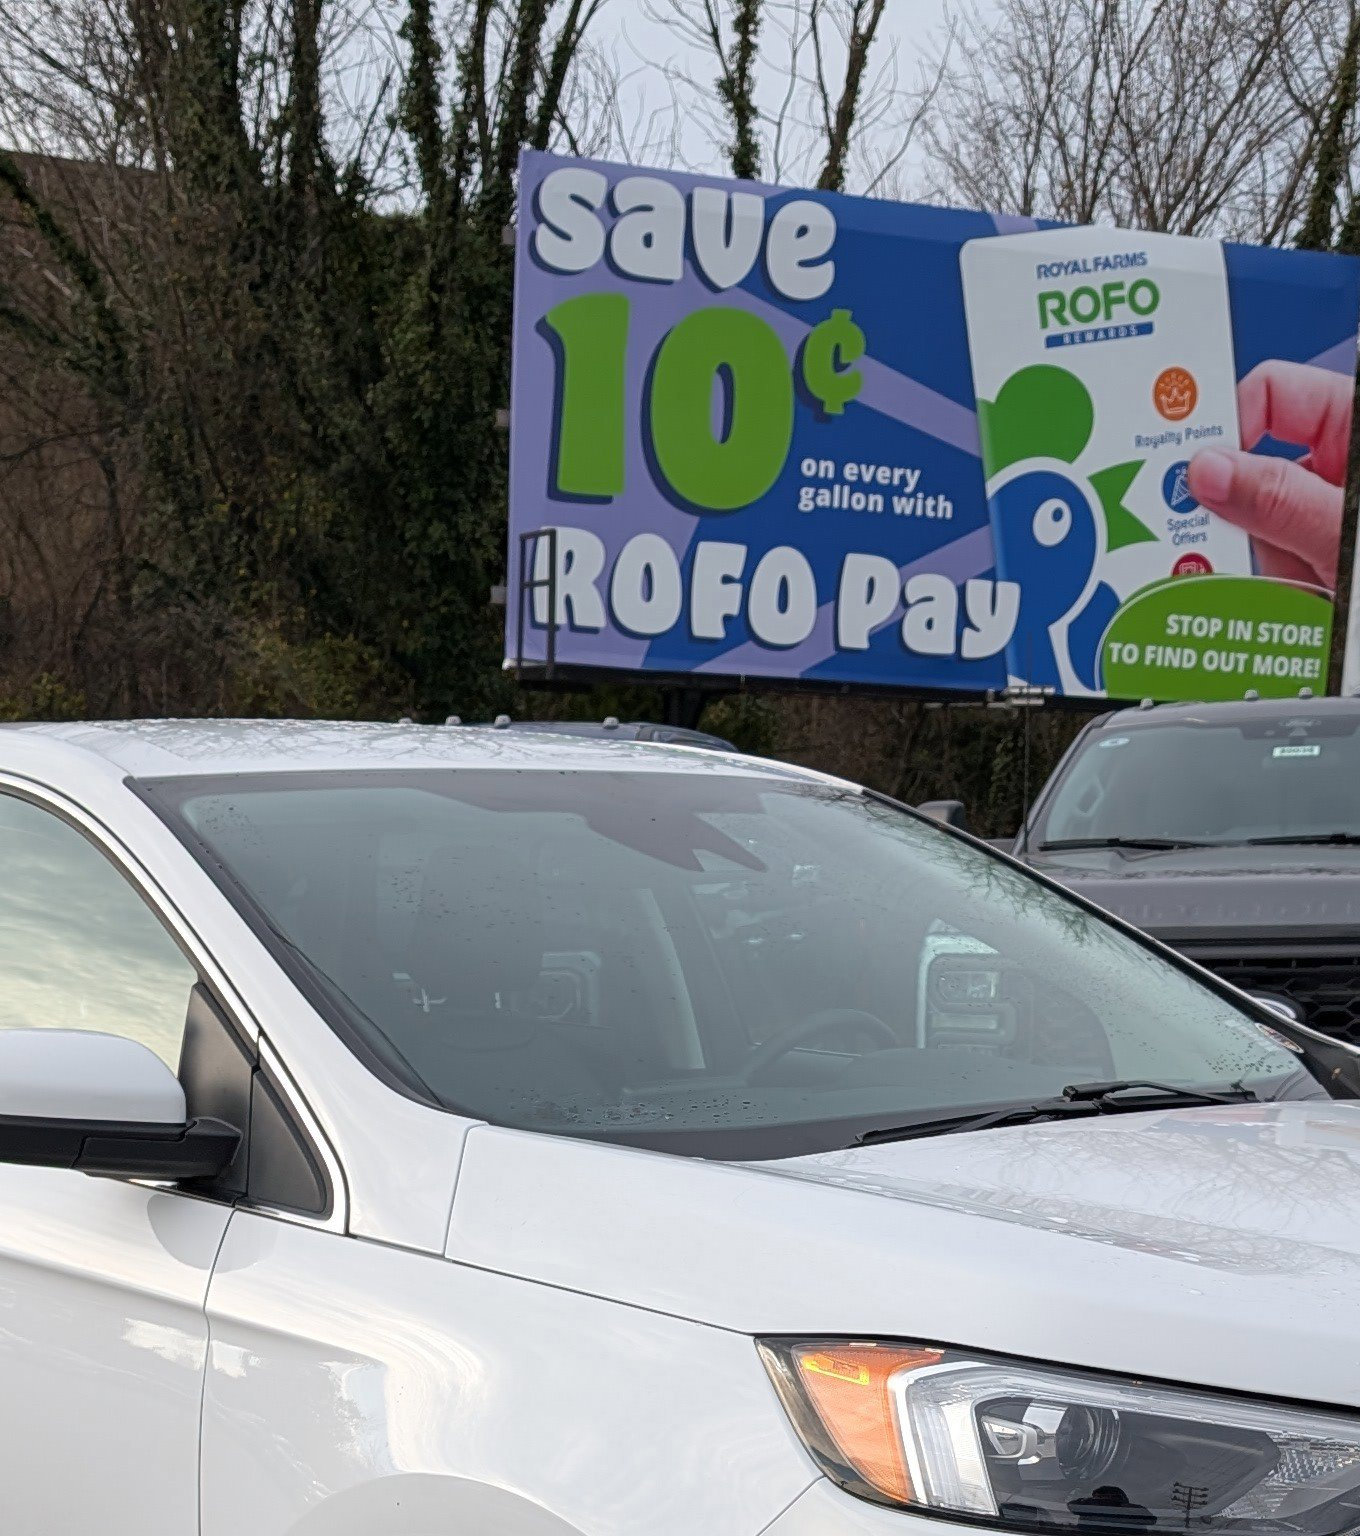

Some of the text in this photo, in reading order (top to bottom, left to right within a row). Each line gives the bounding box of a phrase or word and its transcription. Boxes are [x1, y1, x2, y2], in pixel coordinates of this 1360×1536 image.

[1036, 251, 1148, 280] ROYAL FARMS
[1038, 277, 1160, 330] ROFO
[1062, 323, 1139, 345] REWARDS
[1185, 424, 1224, 441] Points
[800, 457, 922, 494] on every
[797, 483, 954, 520] gallon with
[1166, 512, 1211, 535] Special
[1171, 531, 1208, 546] Offers
[532, 525, 1022, 660] ROFO Pay
[1165, 613, 1325, 647] STOP IN STORE
[1108, 642, 1322, 679] TO FIND OUT MORE!
